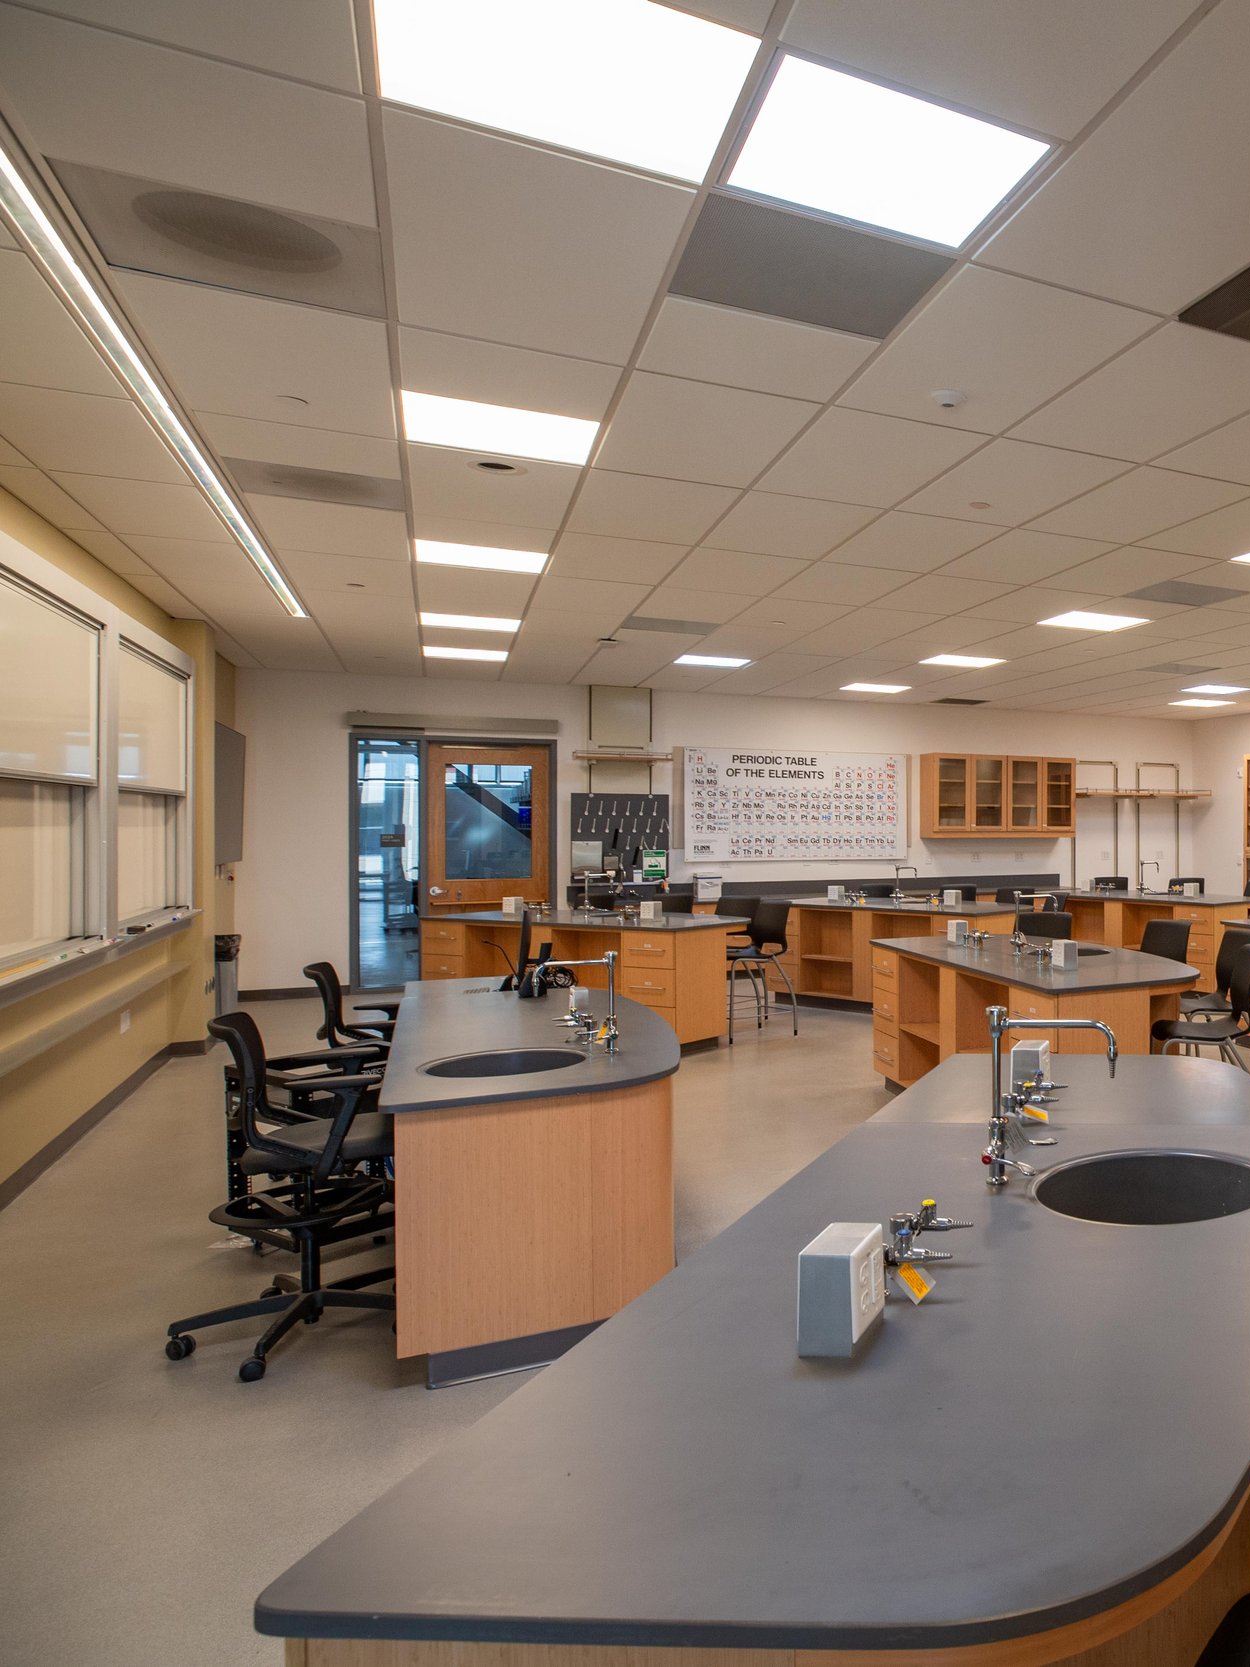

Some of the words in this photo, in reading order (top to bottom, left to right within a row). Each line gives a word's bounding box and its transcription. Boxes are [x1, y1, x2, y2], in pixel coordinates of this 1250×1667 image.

[732, 754, 782, 765] PERIODIC
[786, 756, 817, 766] TABLE
[726, 768, 741, 777] OF
[744, 769, 765, 778] THE
[768, 770, 824, 780] ELEMENTS
